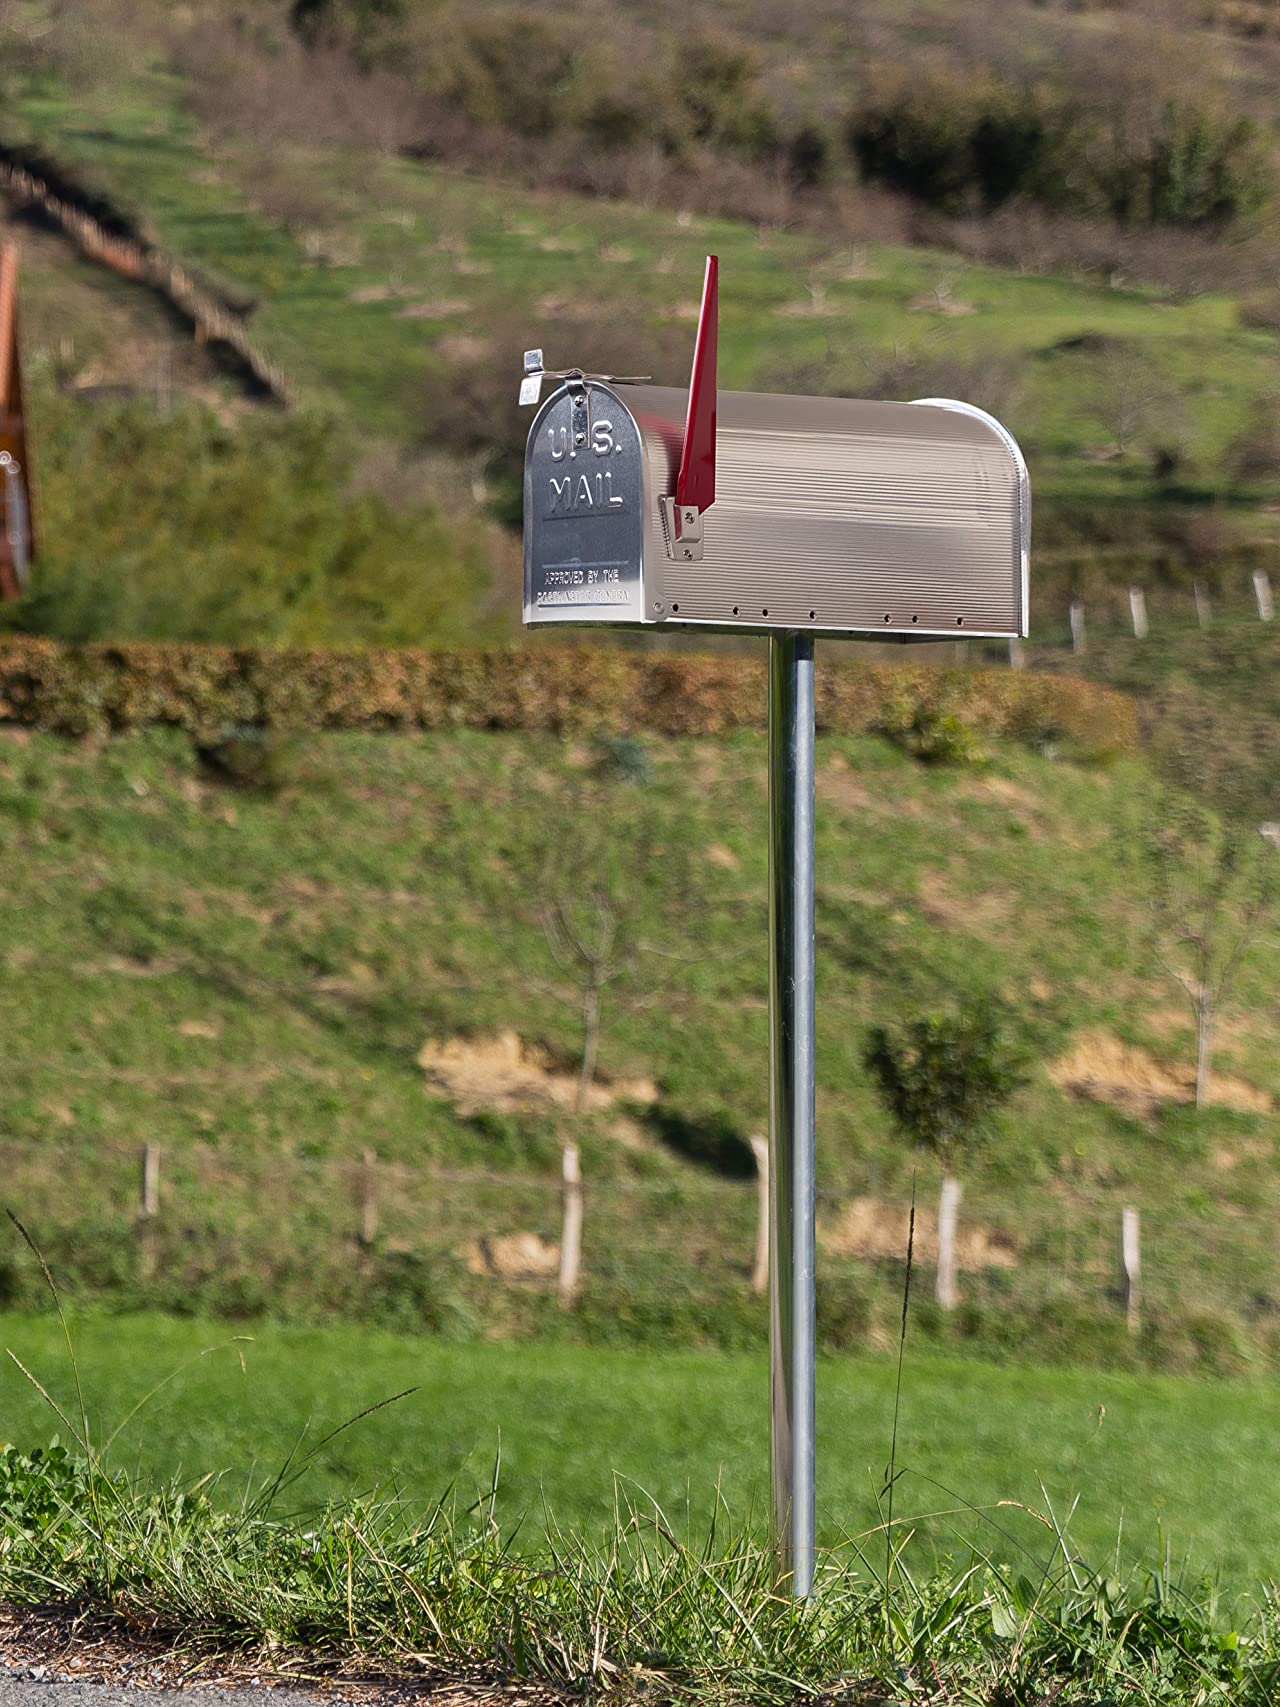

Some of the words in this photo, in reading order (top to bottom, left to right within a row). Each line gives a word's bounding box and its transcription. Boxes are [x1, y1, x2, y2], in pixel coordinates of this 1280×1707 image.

[548, 471, 624, 513] MAIL
[544, 570, 584, 585] APPROVED
[587, 569, 599, 584] BY
[603, 568, 620, 583] THE
